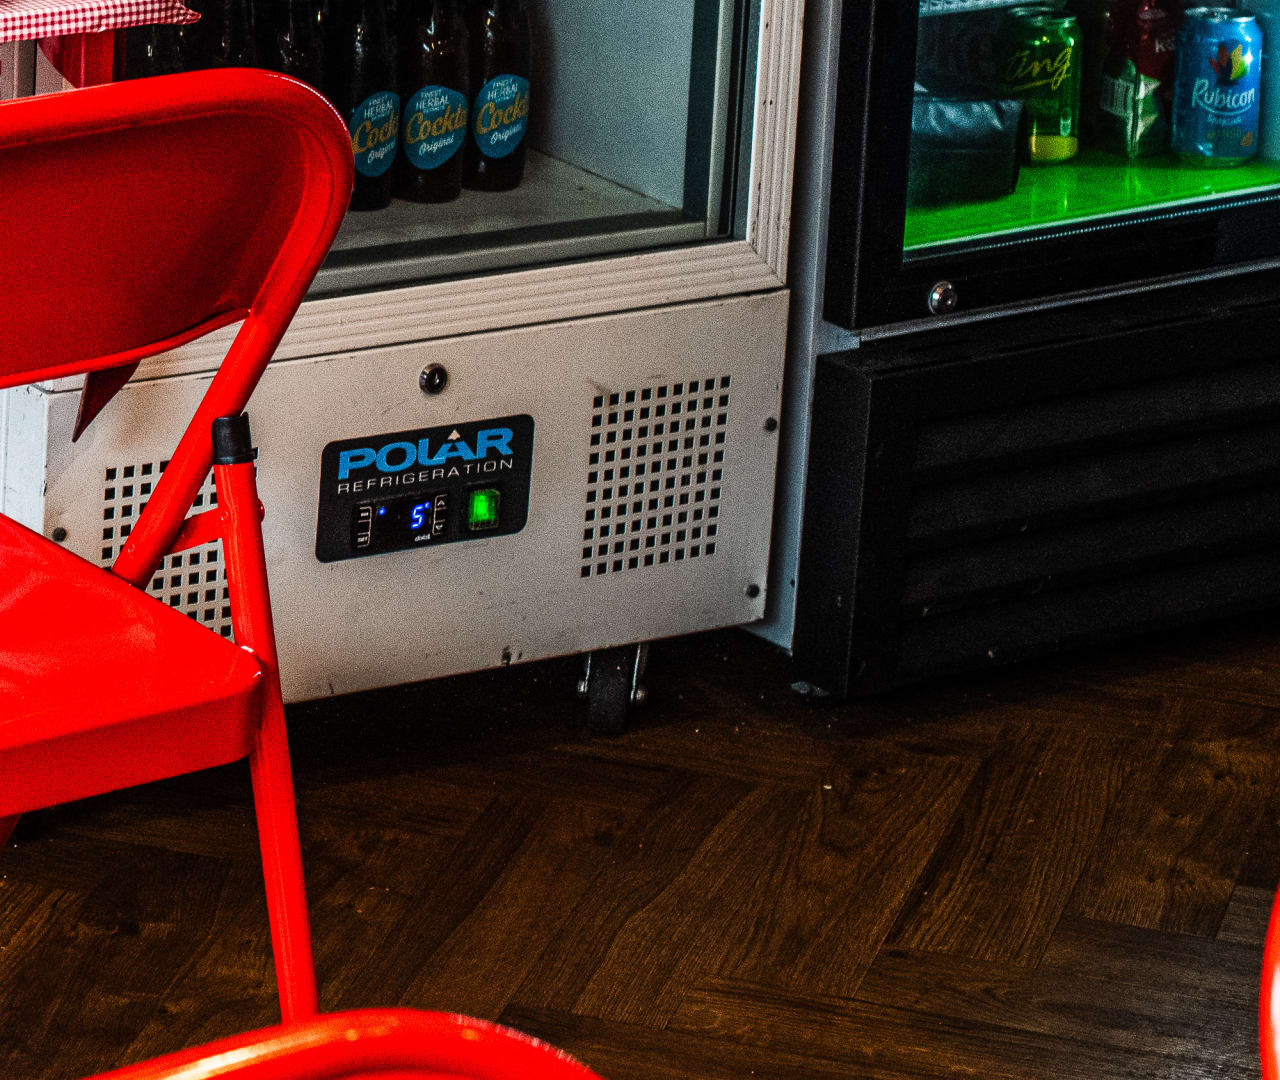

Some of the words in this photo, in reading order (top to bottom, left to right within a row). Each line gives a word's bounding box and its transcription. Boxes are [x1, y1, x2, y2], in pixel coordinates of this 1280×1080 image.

[416, 94, 450, 111] HERBAL
[1191, 78, 1255, 109] Rubicon
[418, 132, 456, 157] Original
[337, 427, 514, 480] POLAR
[337, 457, 514, 495] REFRIGERATION
